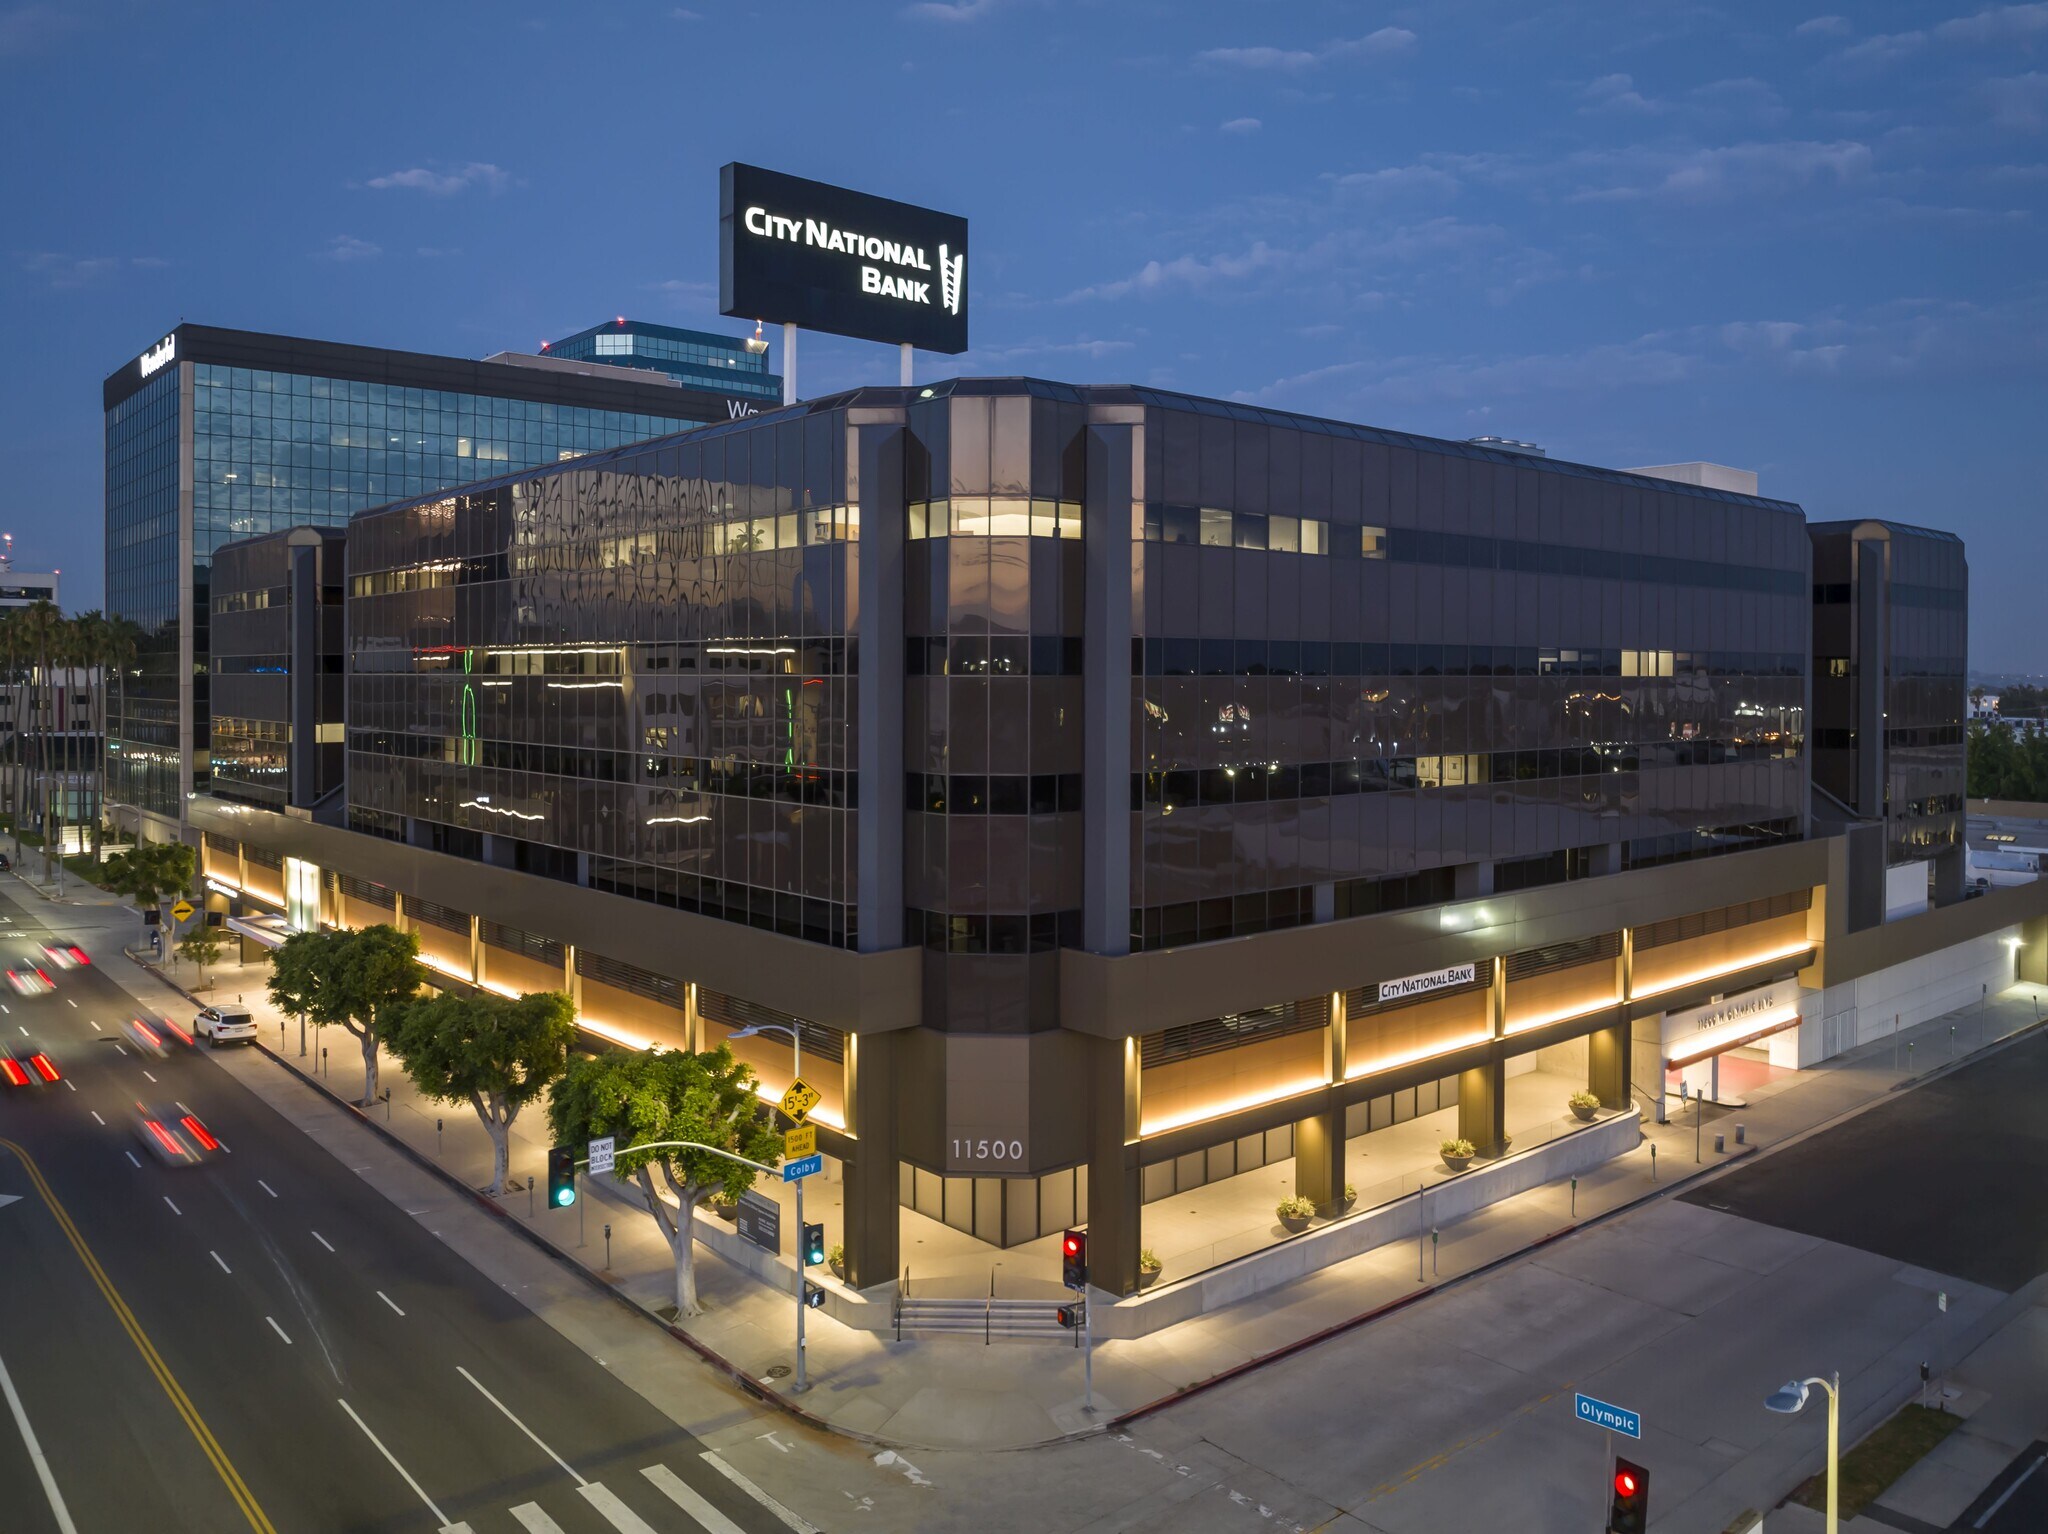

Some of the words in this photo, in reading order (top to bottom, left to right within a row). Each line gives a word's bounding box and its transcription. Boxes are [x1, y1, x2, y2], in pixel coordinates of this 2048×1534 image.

[745, 206, 803, 242] CITY
[806, 218, 931, 271] NATIONAL
[861, 266, 931, 305] BANK
[1382, 984, 1401, 998] CITY
[1402, 974, 1447, 992] NATIONAL
[1448, 968, 1472, 982] BANK
[784, 1092, 814, 1111] 15'-3"
[788, 1133, 803, 1144] 1500
[805, 1131, 813, 1140] FT
[590, 1145, 600, 1154] DO
[600, 1141, 612, 1152] NOT
[791, 1142, 810, 1154] AHEAD
[953, 1139, 1023, 1160] 11500
[591, 1152, 612, 1165] BLOCK
[790, 1162, 816, 1177] Colby
[1581, 1401, 1635, 1431] Olympic
